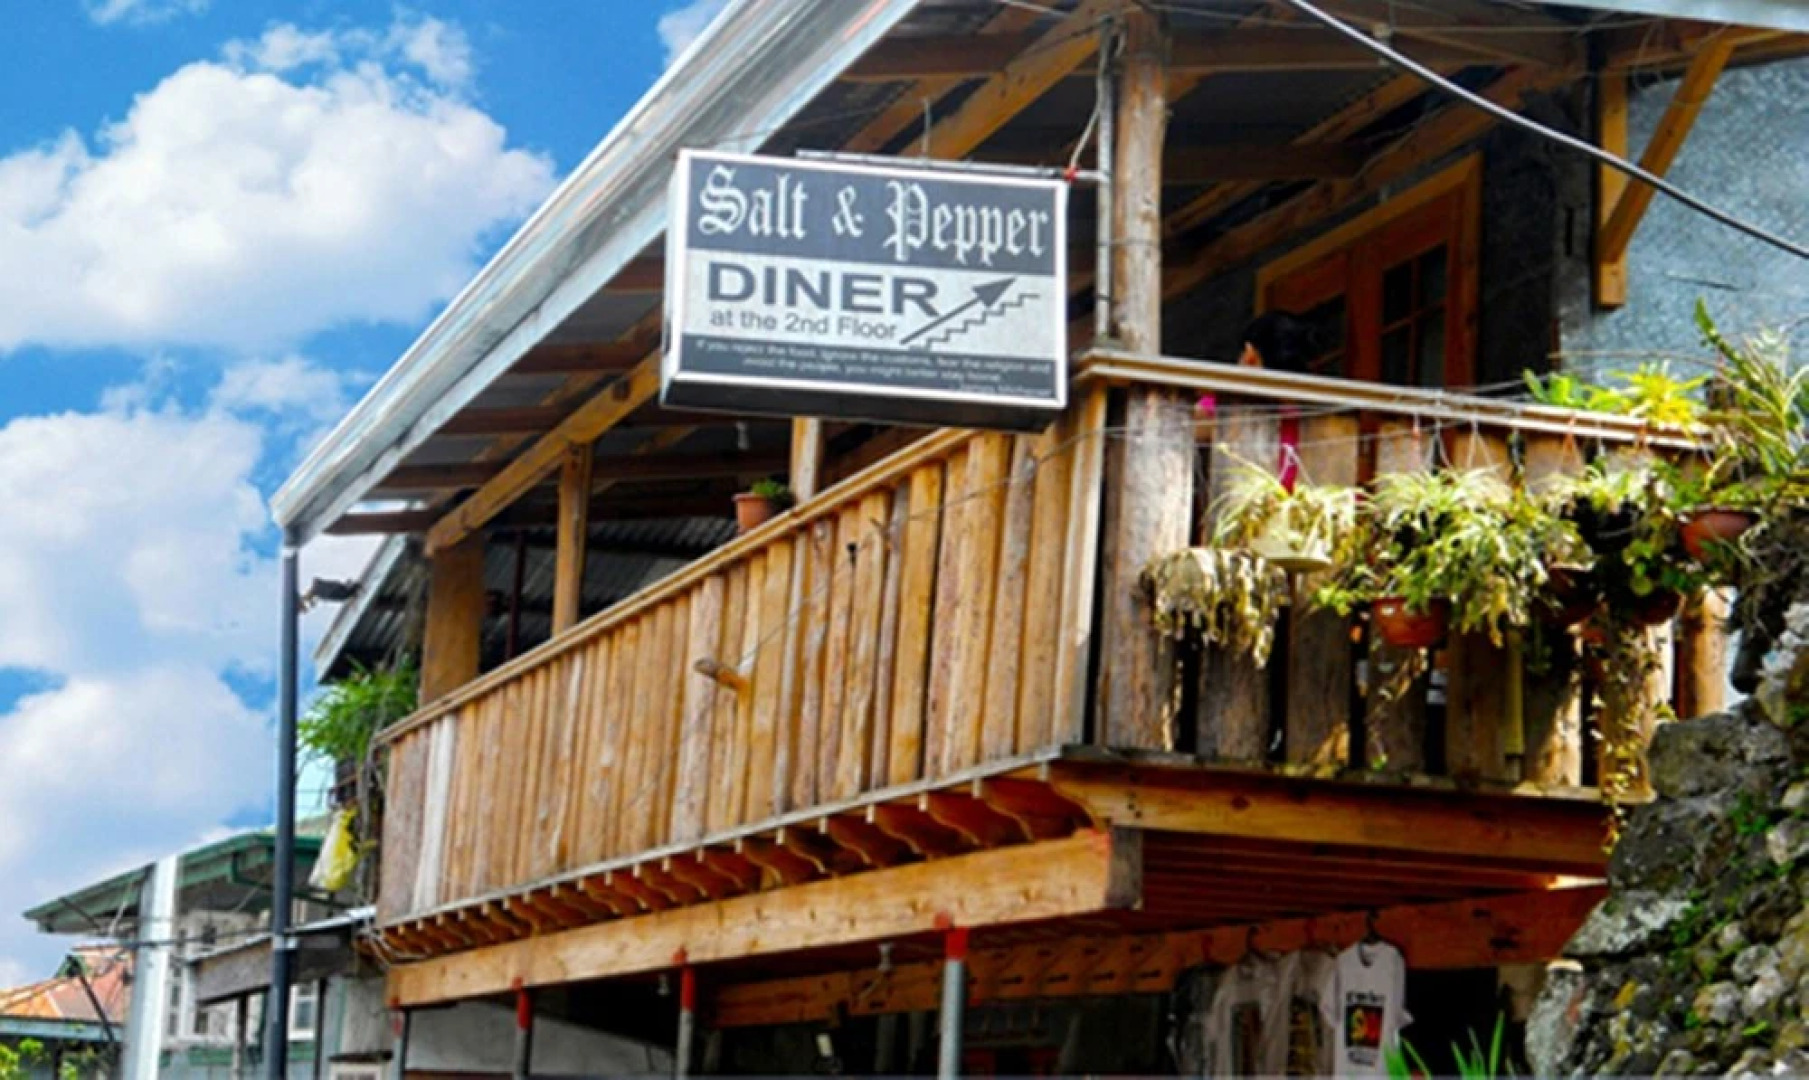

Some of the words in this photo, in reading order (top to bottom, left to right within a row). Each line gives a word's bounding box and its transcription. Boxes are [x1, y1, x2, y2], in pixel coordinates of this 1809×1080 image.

[698, 164, 808, 240] Salt
[831, 184, 866, 238] &
[882, 180, 1050, 267] Pepper
[708, 262, 940, 318] DINER
[710, 310, 733, 328] at
[740, 311, 777, 332] the
[785, 313, 830, 336] 2nd
[837, 316, 897, 340] Floor
[767, 345, 786, 357] the
[860, 352, 879, 363] the
[962, 358, 980, 370] the
[778, 359, 797, 369] the
[844, 364, 867, 376] you
